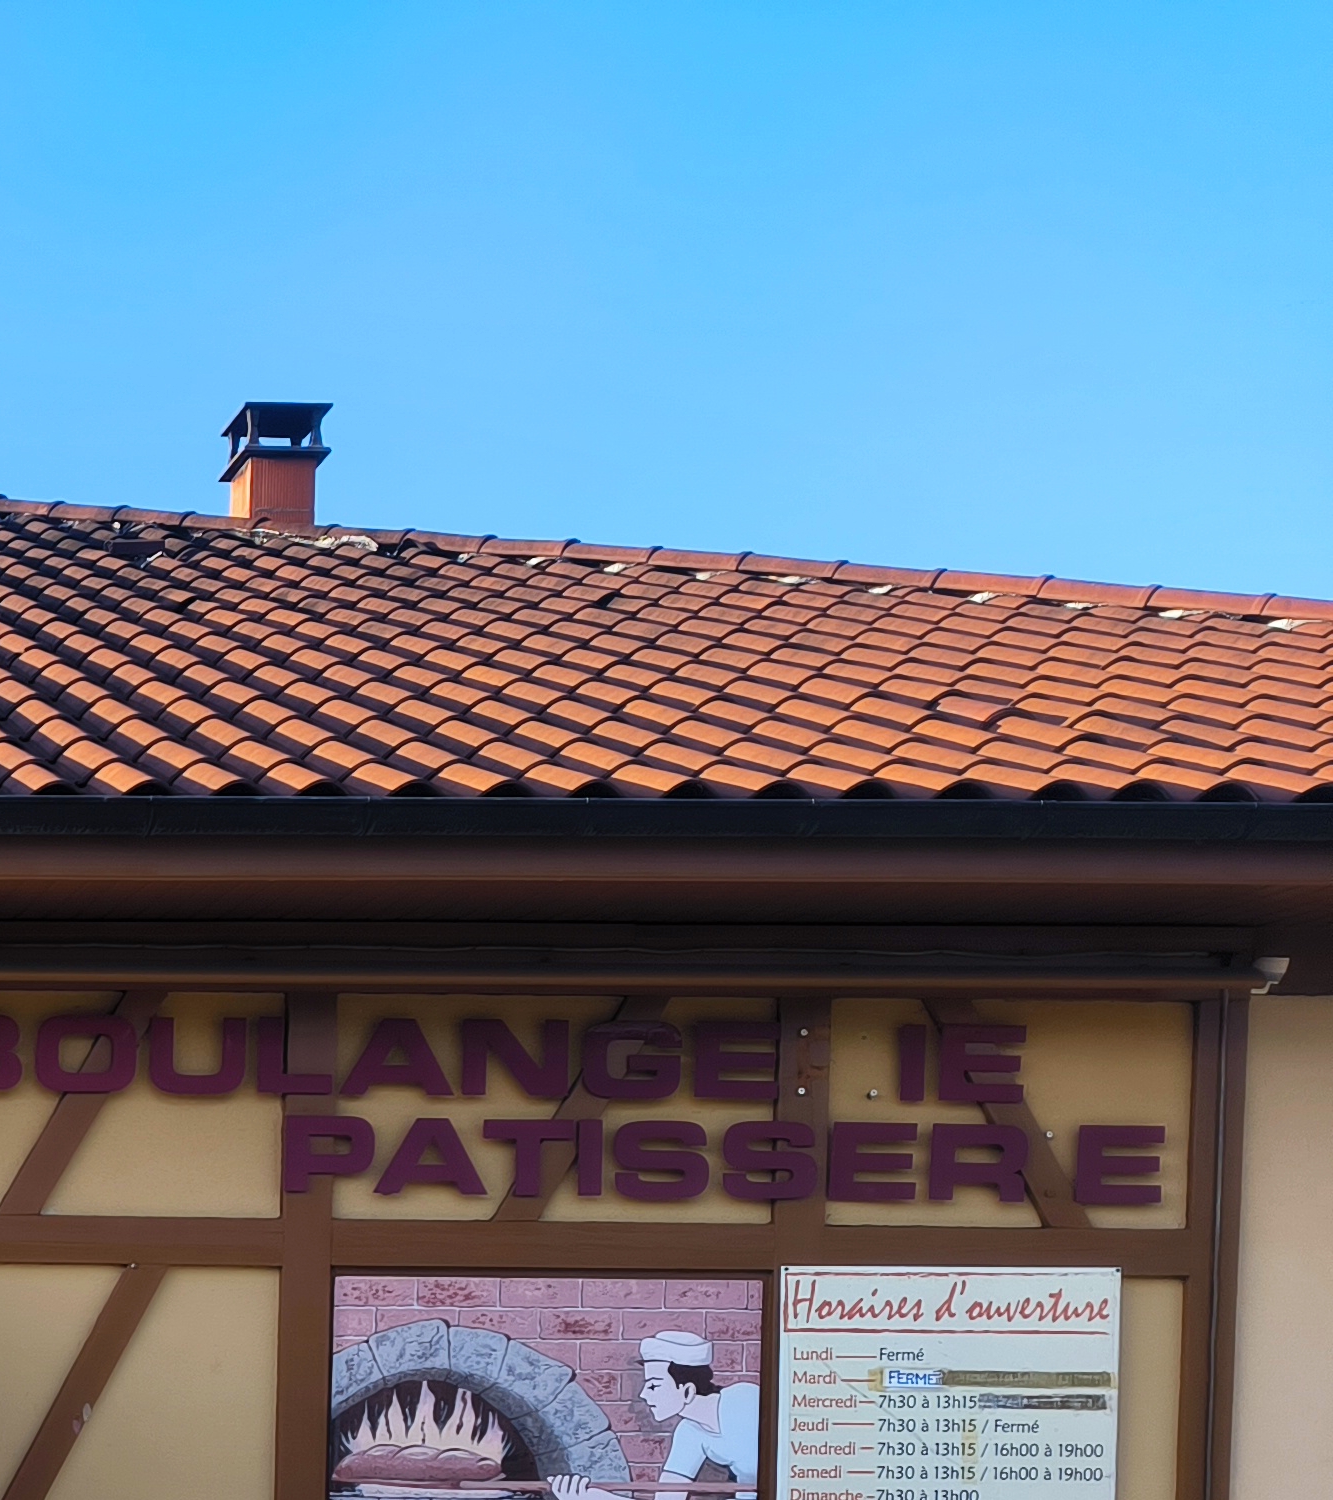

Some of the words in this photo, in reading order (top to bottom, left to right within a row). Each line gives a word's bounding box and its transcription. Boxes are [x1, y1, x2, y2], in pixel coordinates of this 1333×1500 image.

[791, 1279, 925, 1324] Horaires
[935, 1279, 1110, 1323] d'ouverture
[793, 1347, 833, 1361] Lundi
[879, 1347, 925, 1361] Fermé
[792, 1371, 837, 1385] Mardi
[792, 1395, 858, 1409] Mercredi
[879, 1395, 917, 1409] 7h30
[921, 1395, 930, 1409] à
[935, 1395, 978, 1409] 13h15
[791, 1418, 830, 1433] Jeudi
[878, 1418, 916, 1433] 7h30
[921, 1418, 930, 1433] à
[935, 1418, 977, 1433] 13h15
[993, 1419, 1040, 1434] Fermé
[790, 1441, 856, 1456] Vendredi
[877, 1442, 916, 1456] 7h30
[920, 1442, 929, 1456] à
[934, 1442, 977, 1457] 13h15
[993, 1443, 1039, 1458] 16h00
[1044, 1444, 1053, 1458] à
[1058, 1443, 1104, 1458] 19h00
[790, 1465, 843, 1479] Samedi
[877, 1465, 915, 1480] 7h30
[920, 1465, 928, 1480] à
[934, 1465, 976, 1480] 13h15
[992, 1466, 1039, 1481] 16h00
[1044, 1467, 1052, 1481] à
[1057, 1467, 1104, 1482] 19h00
